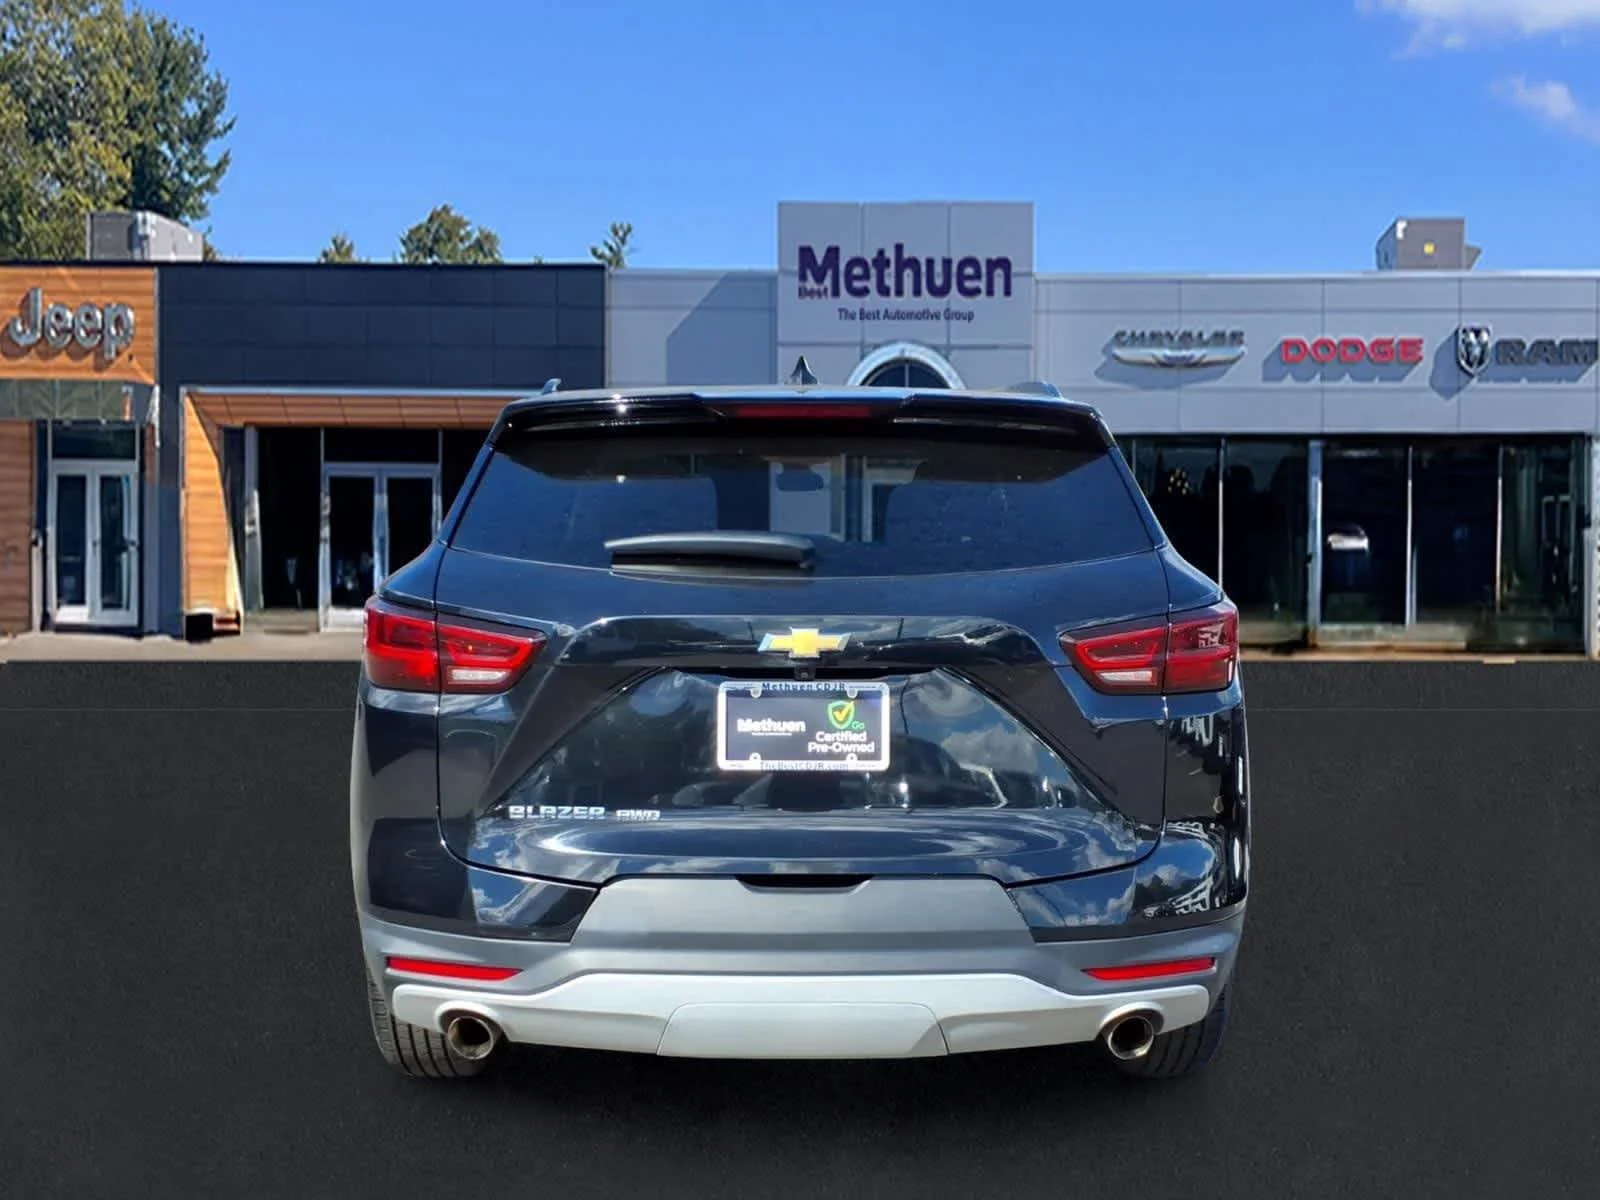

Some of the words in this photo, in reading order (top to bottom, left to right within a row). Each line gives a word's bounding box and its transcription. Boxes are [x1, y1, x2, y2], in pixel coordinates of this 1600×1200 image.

[797, 243, 1012, 299] Methuen
[9, 287, 135, 360] Jeep
[838, 308, 856, 321] The
[859, 308, 881, 321] Best
[883, 308, 941, 321] Automotive
[944, 309, 975, 323] Group
[1113, 329, 1245, 346] CHRYSLER
[1281, 338, 1424, 364] DODGE
[1495, 338, 1599, 366] RAM
[737, 718, 806, 733] Methuen
[816, 731, 867, 742] Certified
[808, 741, 875, 753] Pre-Owned
[508, 805, 606, 820] BLAZER
[615, 809, 661, 821] AWD
